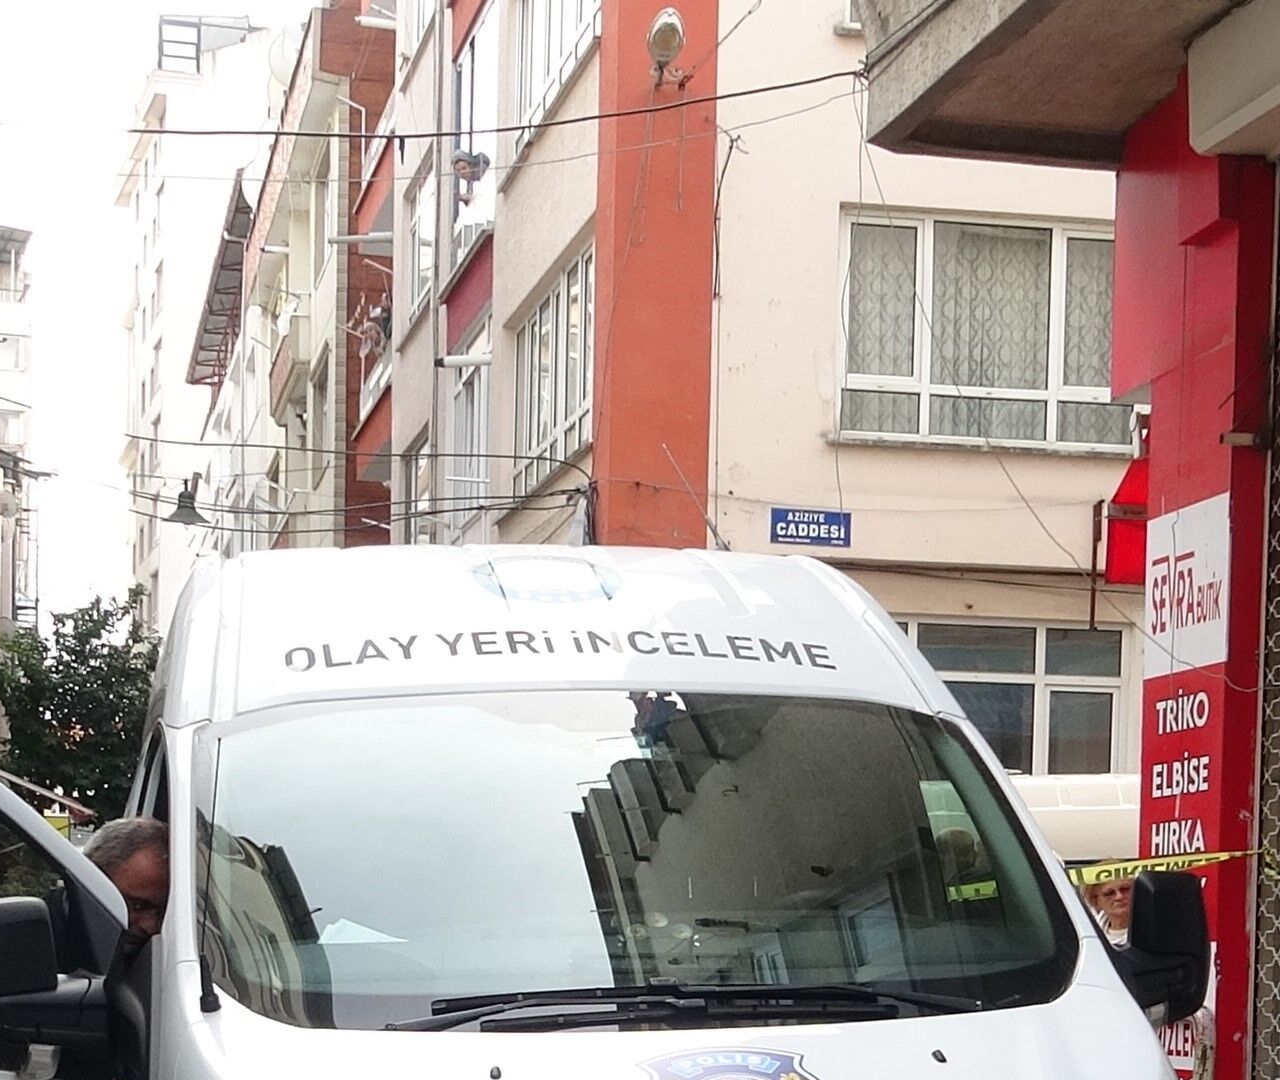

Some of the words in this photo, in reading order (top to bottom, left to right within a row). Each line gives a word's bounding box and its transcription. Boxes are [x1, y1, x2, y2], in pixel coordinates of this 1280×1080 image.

[1152, 551, 1195, 636] SEVRA
[284, 635, 418, 673] OLAY
[1155, 688, 1209, 735] TRİKO
[1151, 751, 1210, 798] ELBİSE
[1151, 818, 1205, 857] HIRKA
